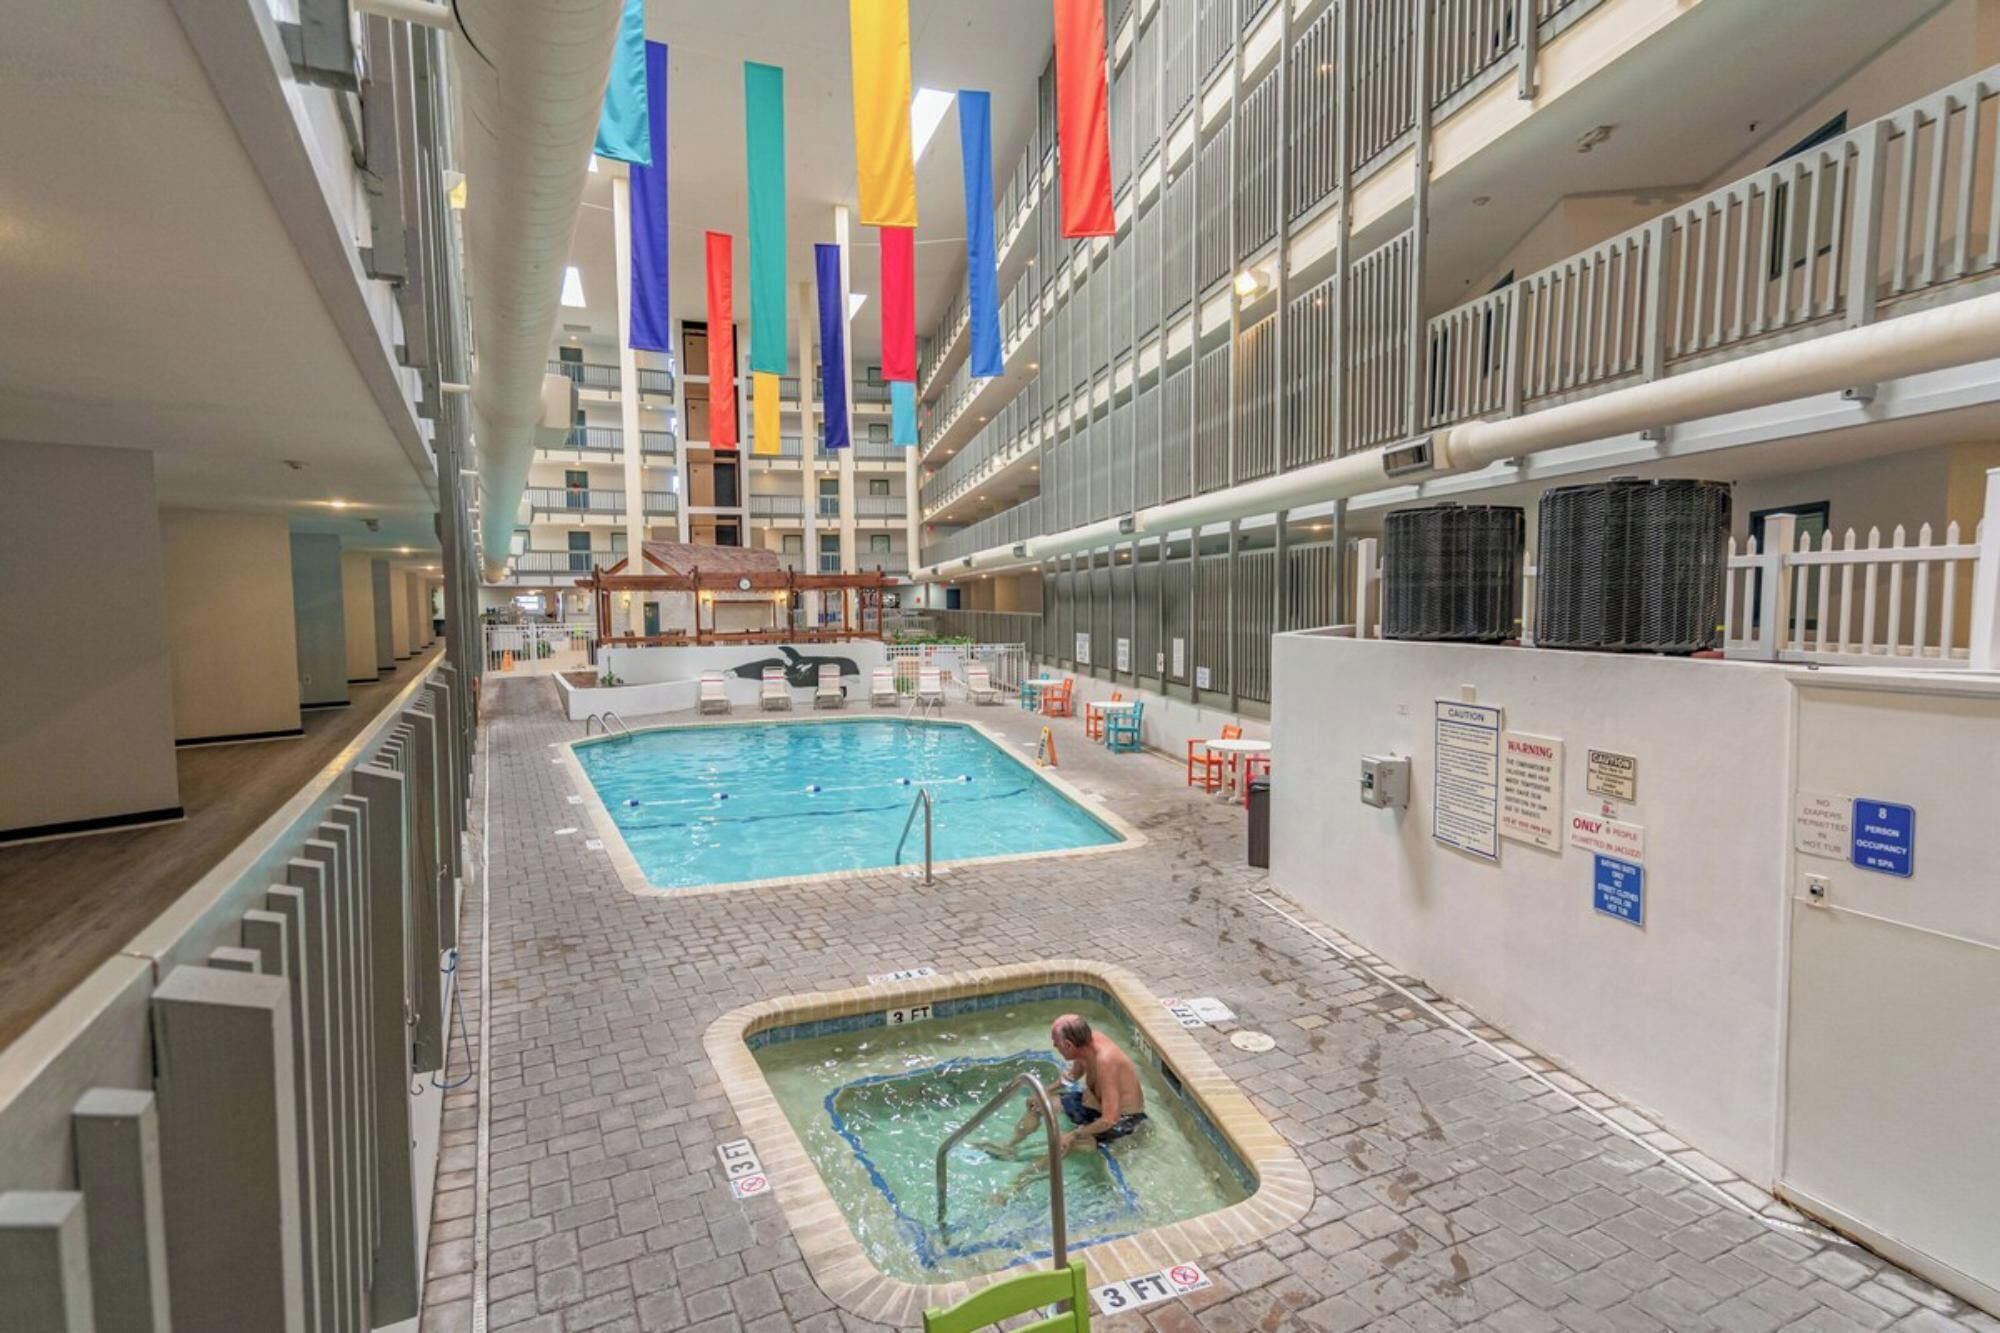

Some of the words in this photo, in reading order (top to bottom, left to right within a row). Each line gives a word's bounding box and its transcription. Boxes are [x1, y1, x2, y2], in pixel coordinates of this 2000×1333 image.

[1447, 708, 1485, 723] CAUTION
[1507, 740, 1553, 759] WARNING
[1592, 752, 1632, 769] CAUTION
[1816, 799, 1831, 808] NO
[1803, 807, 1843, 820] DIAPERS
[1878, 806, 1888, 819] 8
[1573, 817, 1602, 834] ONLY
[1613, 828, 1637, 841] PEOPLE
[1797, 818, 1849, 833] PERMITTED
[1864, 824, 1900, 838] PERSON
[1606, 842, 1614, 850] IN
[1615, 844, 1642, 859] JACUZZI
[1802, 840, 1821, 851] HOT
[1824, 843, 1842, 853] TUB
[1856, 839, 1908, 855] OCCUPANCY
[1866, 857, 1876, 866] IN
[1877, 859, 1895, 870] SPA
[1597, 882, 1616, 895] STREET
[1609, 895, 1622, 906] POOL
[1606, 902, 1617, 912] HOT
[1618, 905, 1628, 916] TUB
[893, 1011, 904, 1024] 3
[911, 1006, 929, 1021] FT
[721, 1141, 751, 1160] FT
[730, 1160, 755, 1174] 3
[1102, 1287, 1127, 1308] 3
[1130, 1275, 1169, 1301] FT
